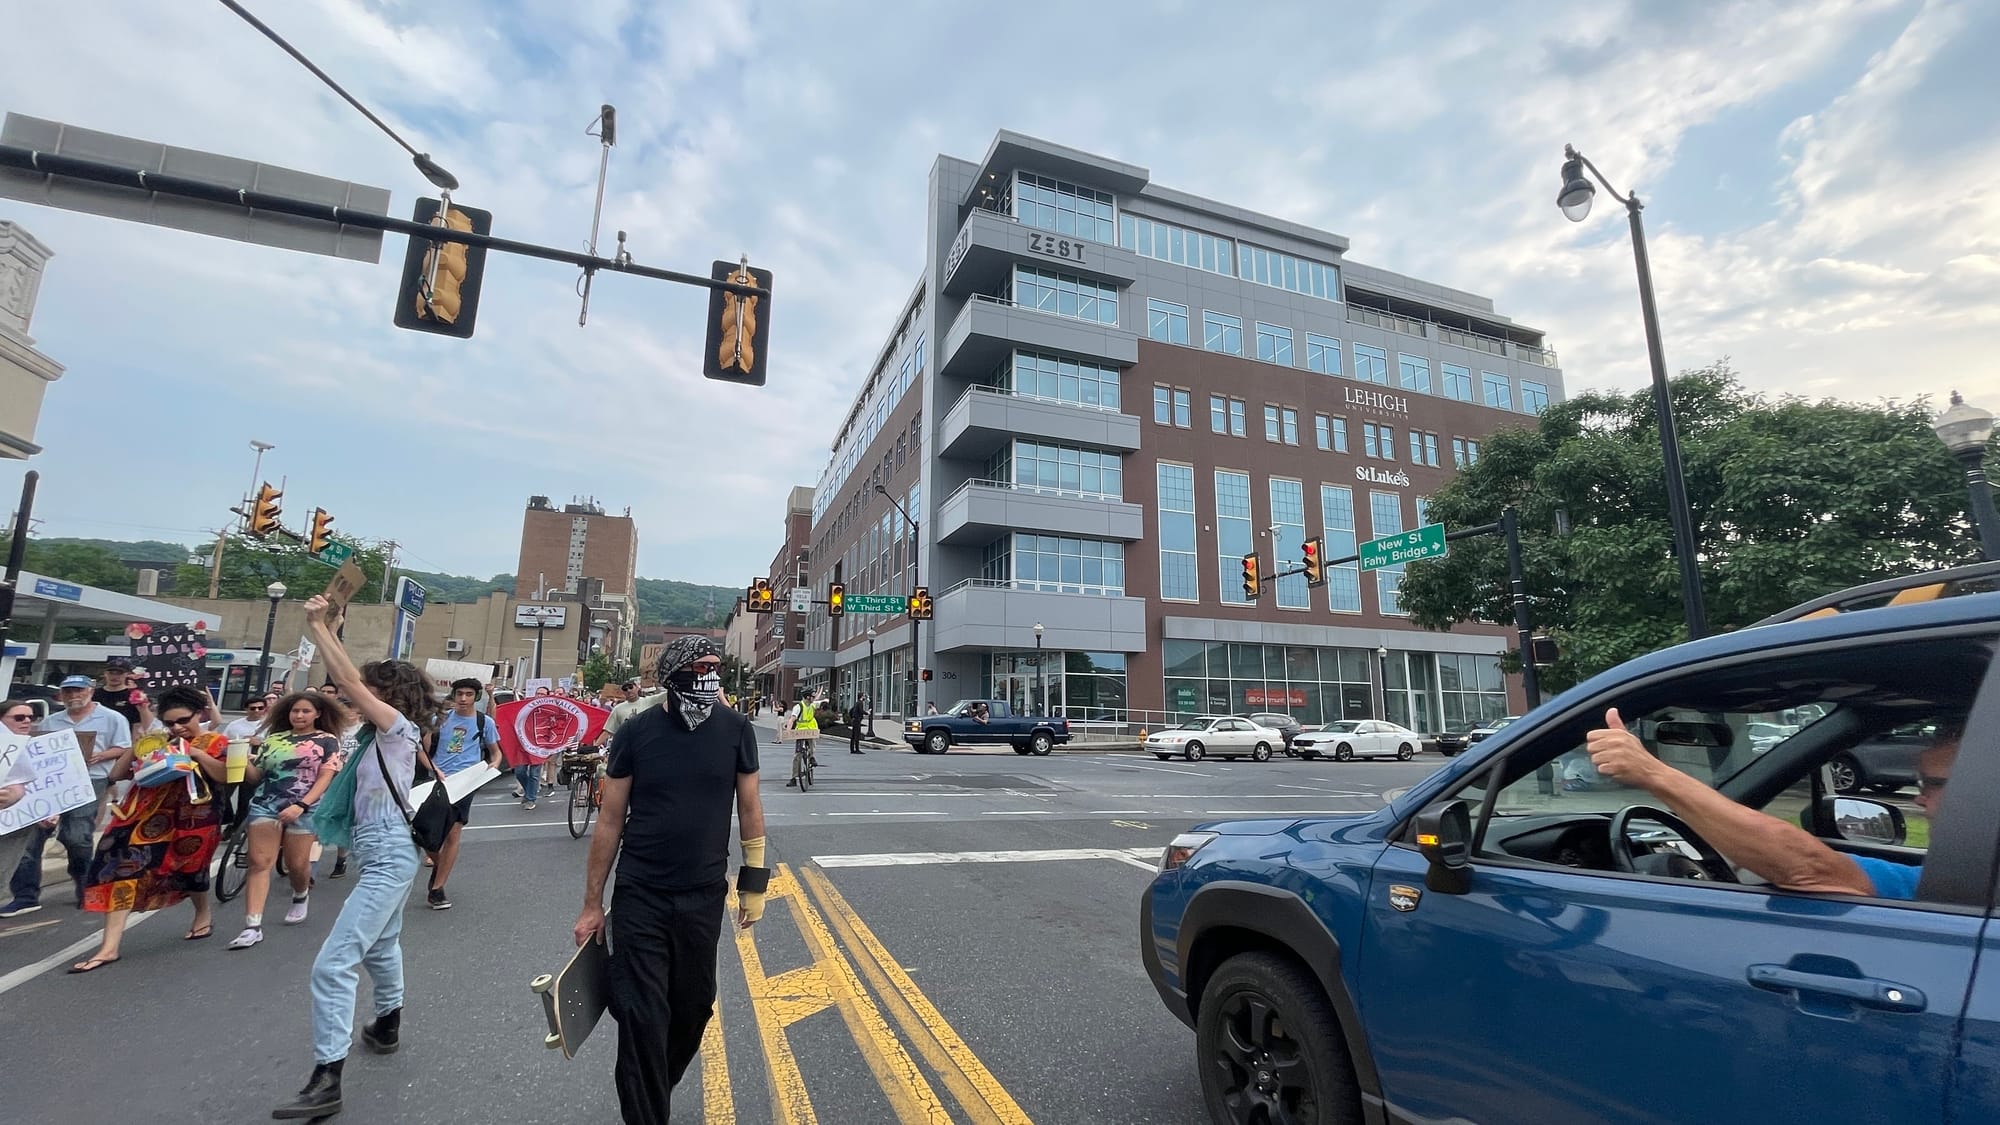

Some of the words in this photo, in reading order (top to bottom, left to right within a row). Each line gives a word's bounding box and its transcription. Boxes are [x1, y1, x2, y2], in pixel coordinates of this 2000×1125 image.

[1030, 232, 1085, 260] ZEST
[1344, 387, 1408, 413] LEHIGH
[1345, 403, 1408, 420] UNIVERSITY
[1378, 539, 1403, 552] New
[1408, 533, 1423, 544] St
[1364, 555, 1387, 568] Fahy
[1392, 546, 1428, 561] Bridge
[865, 596, 887, 604] Third
[146, 634, 195, 643] LOVE
[143, 669, 197, 678] BELLA
[942, 671, 957, 680] 306
[692, 680, 703, 690] LA
[555, 700, 580, 715] VALLEY
